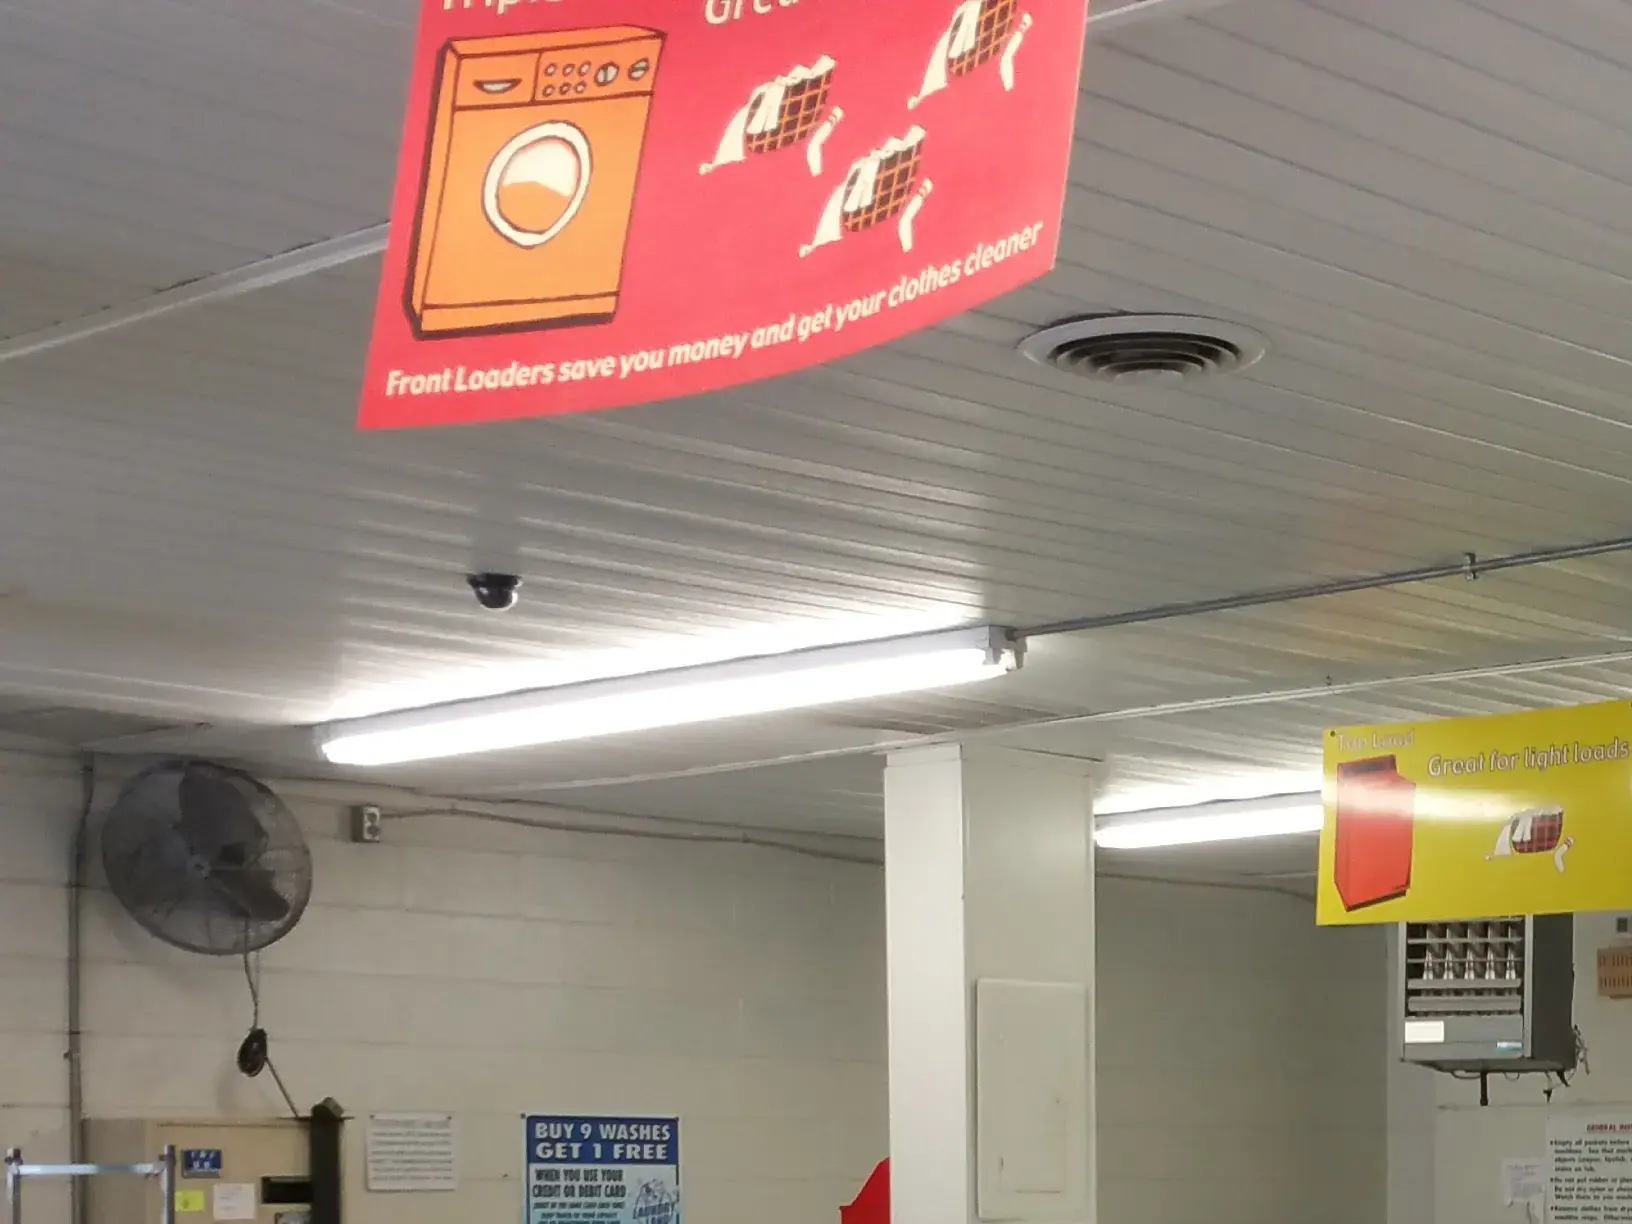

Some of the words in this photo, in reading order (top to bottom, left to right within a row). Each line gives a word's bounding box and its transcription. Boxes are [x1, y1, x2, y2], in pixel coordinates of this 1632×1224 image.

[385, 367, 453, 398] Front
[455, 360, 555, 392] Loaders
[557, 355, 615, 382] save
[618, 348, 664, 378] you
[668, 333, 751, 366] money
[750, 312, 796, 349] and
[796, 304, 833, 342] get
[834, 290, 887, 331] your
[887, 258, 961, 310] clothes
[963, 221, 1044, 277] cleaner
[1427, 752, 1485, 778] Great
[1490, 750, 1520, 772] for
[1523, 743, 1569, 770] light
[1573, 736, 1630, 763] loads
[535, 1123, 574, 1140] BUY
[580, 1123, 592, 1140] 9
[599, 1123, 671, 1141] WASHES
[535, 1142, 583, 1160] GET
[593, 1142, 602, 1159] 1
[613, 1143, 668, 1160] FREE
[562, 1168, 581, 1182] YOU
[583, 1169, 599, 1182] USE
[601, 1168, 624, 1182] YOUR
[604, 1185, 627, 1198] CARD
